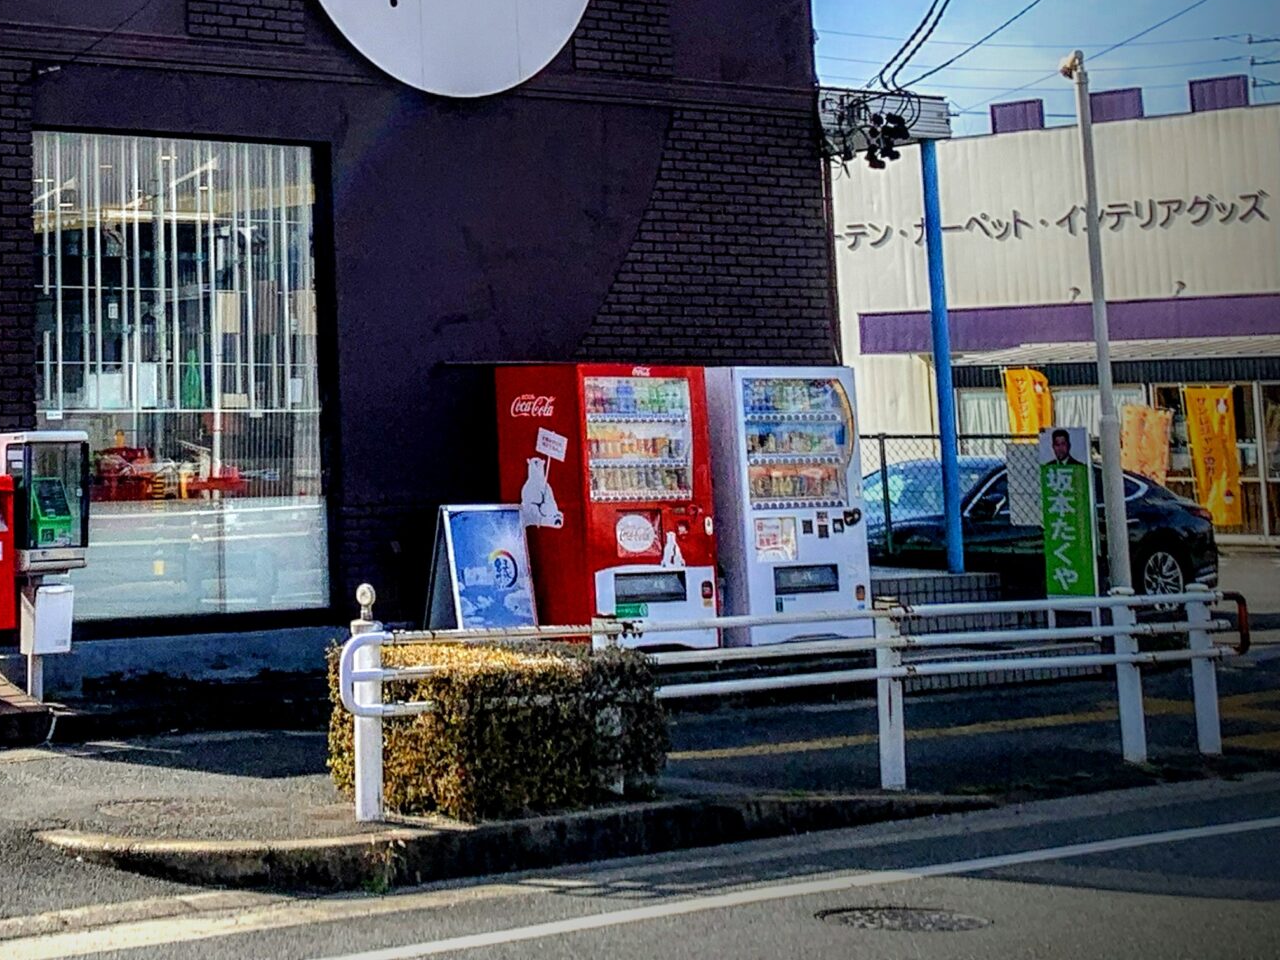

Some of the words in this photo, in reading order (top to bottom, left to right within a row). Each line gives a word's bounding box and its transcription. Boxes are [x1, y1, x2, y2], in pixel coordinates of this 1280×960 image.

[1046, 467, 1079, 591] 坂本たくや
